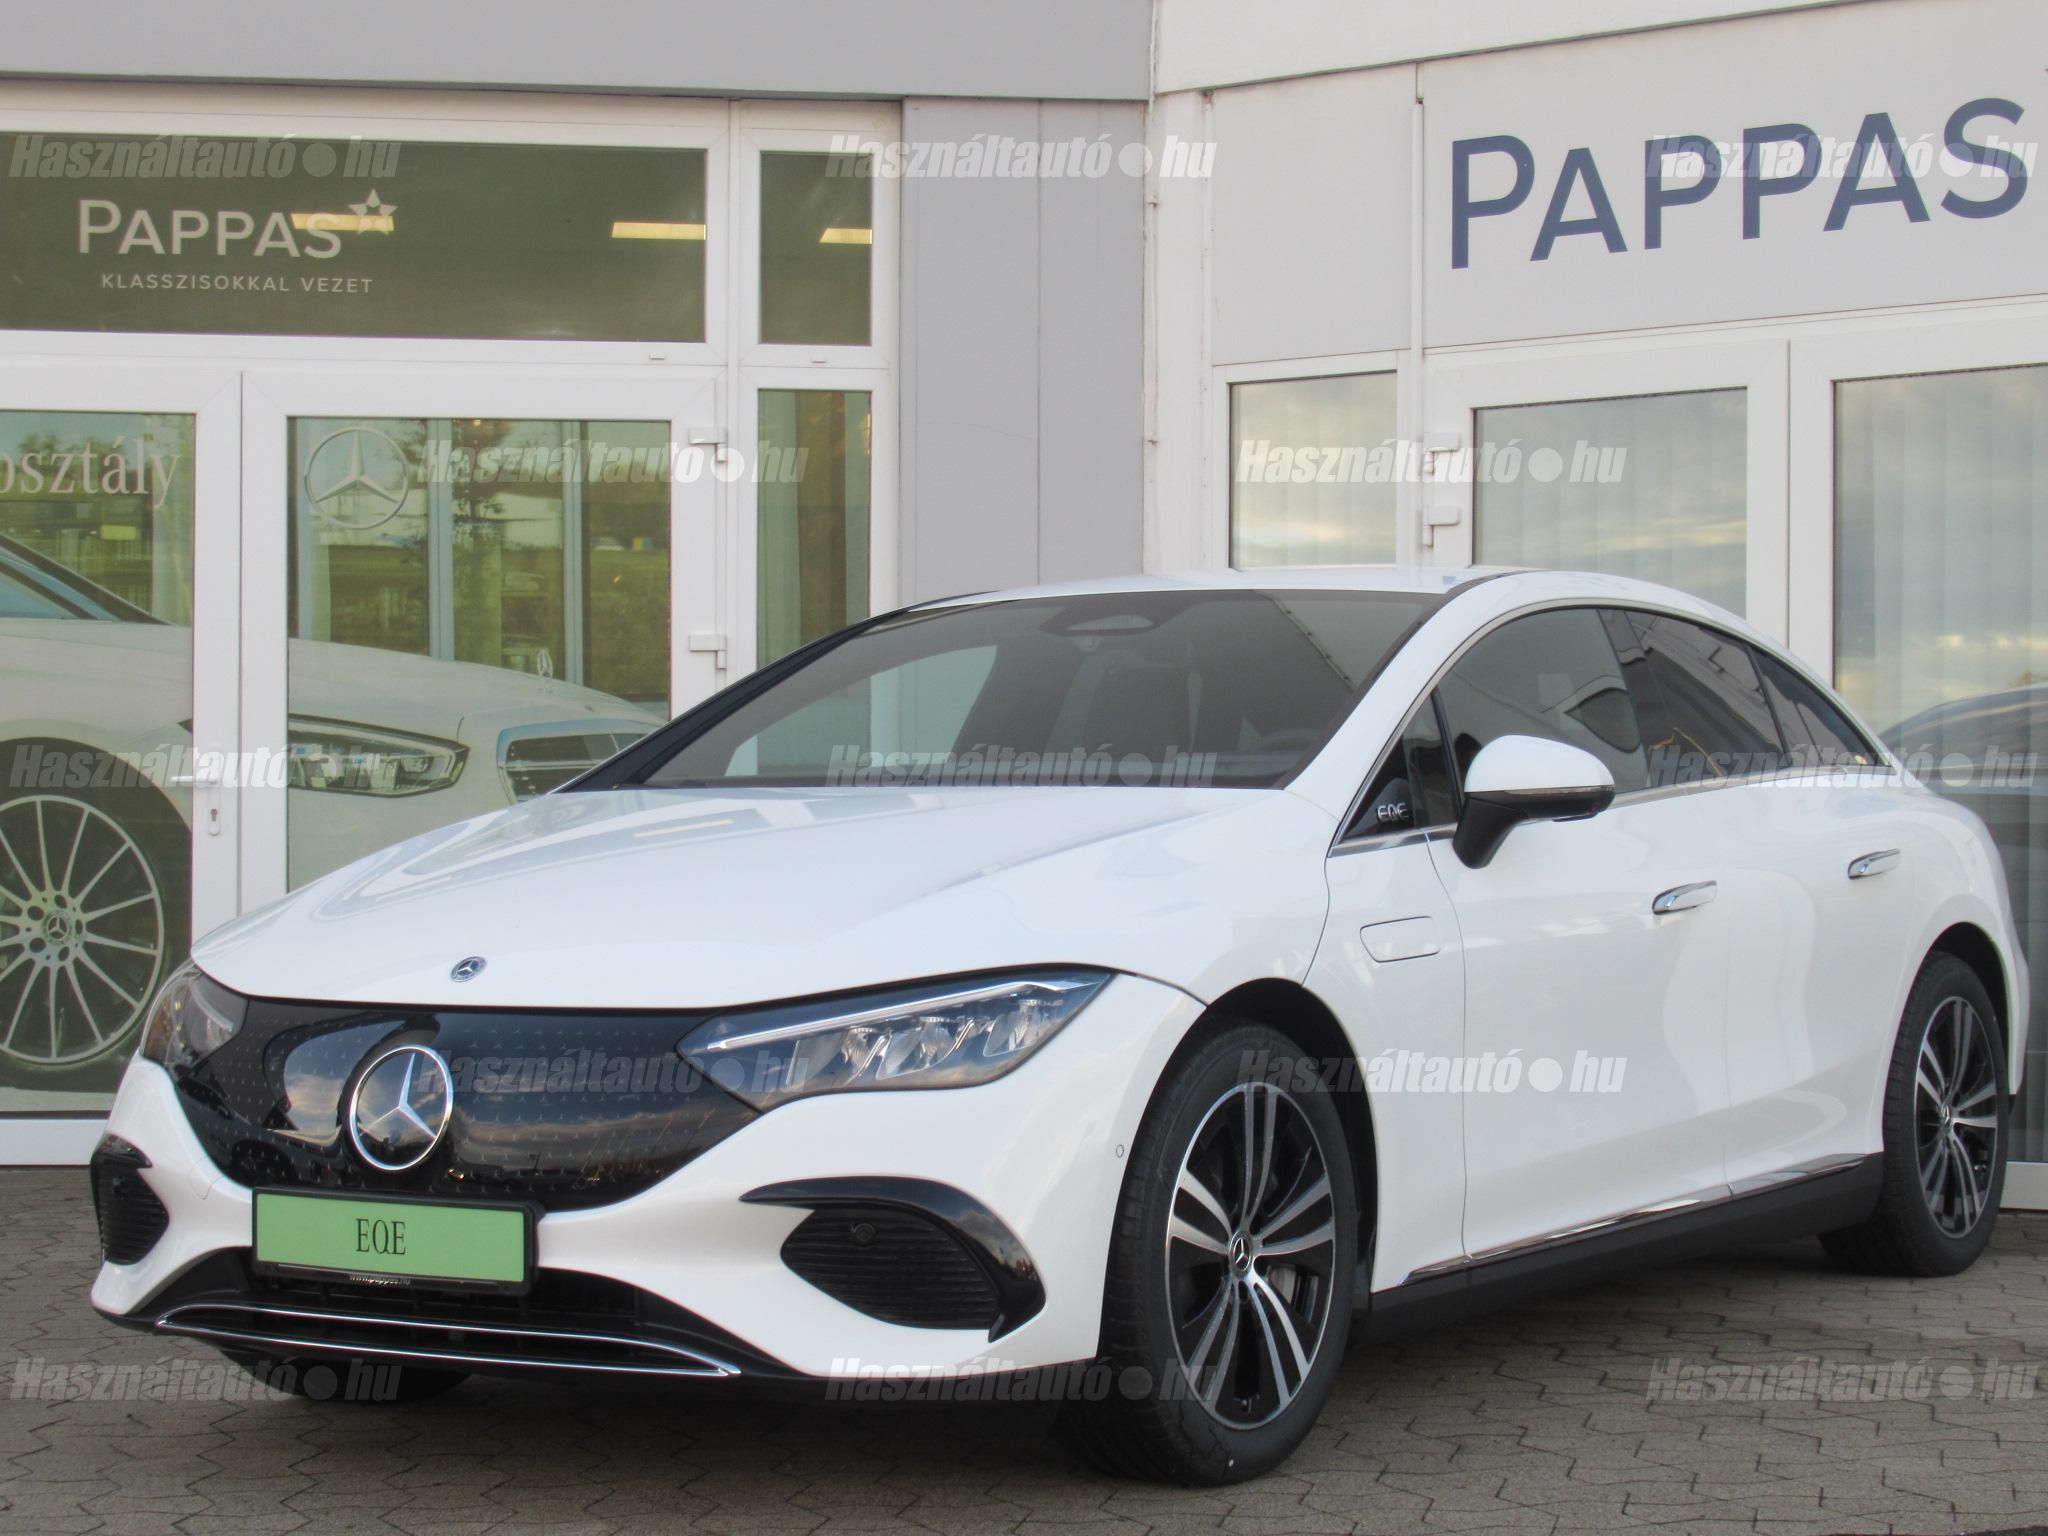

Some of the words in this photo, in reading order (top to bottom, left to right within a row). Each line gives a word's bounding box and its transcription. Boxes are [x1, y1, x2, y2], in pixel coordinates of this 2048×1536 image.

[1451, 97, 2029, 269] PAPPAS
[79, 199, 342, 259] PAPPAS
[101, 273, 290, 291] KLASSZISOKKAL
[301, 276, 373, 293] VEZET
[356, 1218, 406, 1255] EQE
